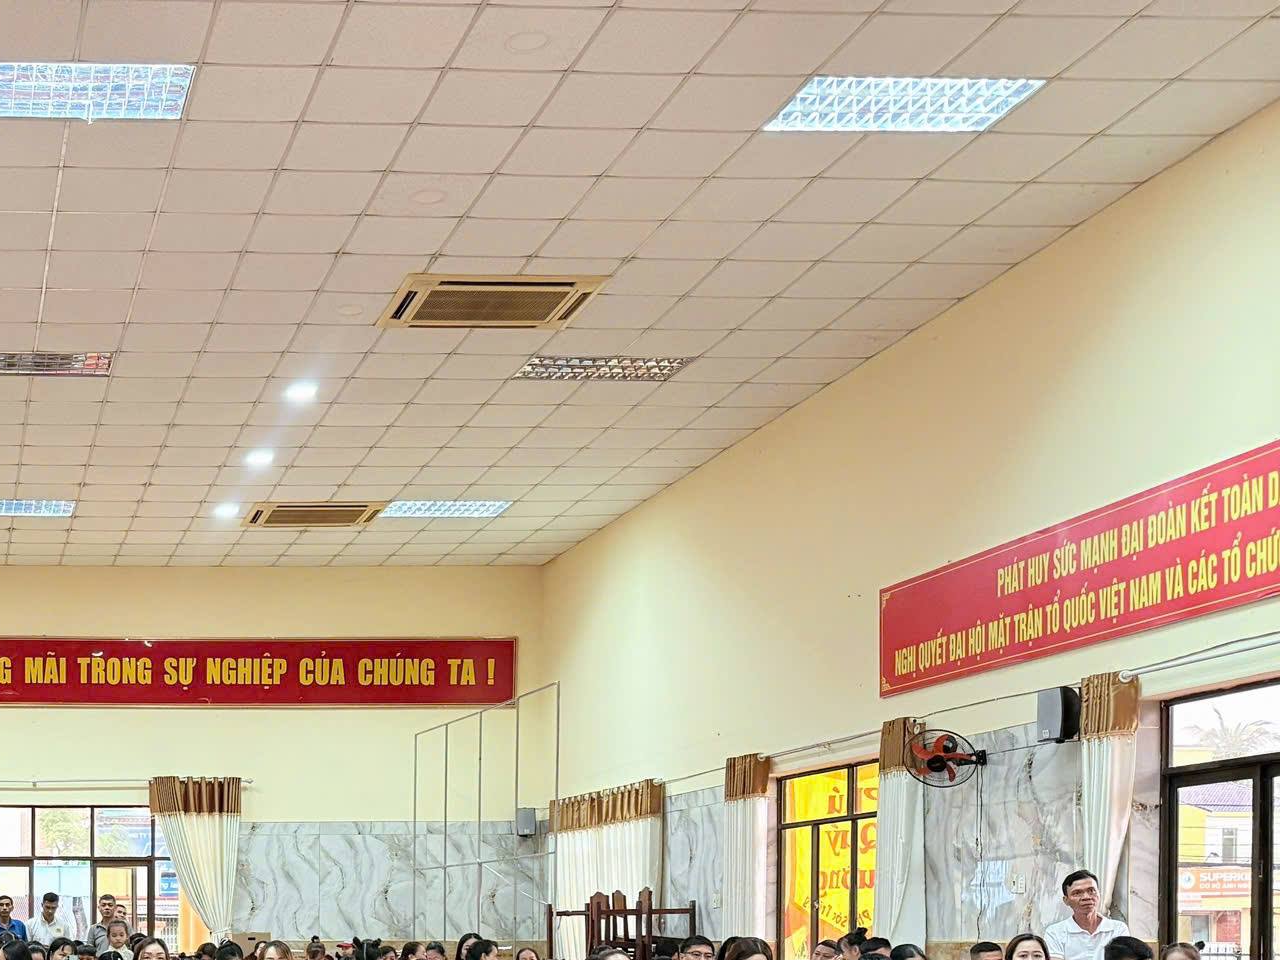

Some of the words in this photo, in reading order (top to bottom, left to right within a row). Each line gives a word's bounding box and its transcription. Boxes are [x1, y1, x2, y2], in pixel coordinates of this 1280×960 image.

[997, 556, 1024, 597] PHÁT
[1028, 554, 1049, 585] HUY
[1053, 531, 1077, 579] SỨC
[1081, 530, 1118, 571] MẠNH
[1121, 519, 1143, 559] ĐẠI
[1148, 500, 1186, 548] ĐOÀN
[1191, 485, 1218, 534] KẾT
[1222, 474, 1263, 523] TOÀN
[1268, 471, 1280, 508] D
[896, 646, 915, 676] NGHỊ
[919, 629, 947, 672] QUYẾT
[950, 631, 965, 664] ĐẠI
[969, 621, 985, 659] HỘI
[989, 614, 1010, 653] MẶT
[1014, 604, 1042, 646] TRẬN
[1046, 590, 1060, 634] TỔ
[1064, 582, 1095, 632] QUỐC
[1099, 578, 1126, 623] VIỆT
[1130, 571, 1161, 611] NAM
[1165, 558, 1184, 600] VÀ
[1188, 550, 1217, 594] CÁC
[1222, 532, 1242, 584] TỔ
[25, 652, 66, 683] MÃI
[78, 656, 151, 685] TRONG
[164, 658, 196, 689] SỰ
[207, 653, 286, 689] NGHIỆP
[300, 651, 345, 685] CỦA
[358, 653, 434, 685] CHÚNG
[448, 659, 475, 685] TA
[488, 659, 494, 684] !
